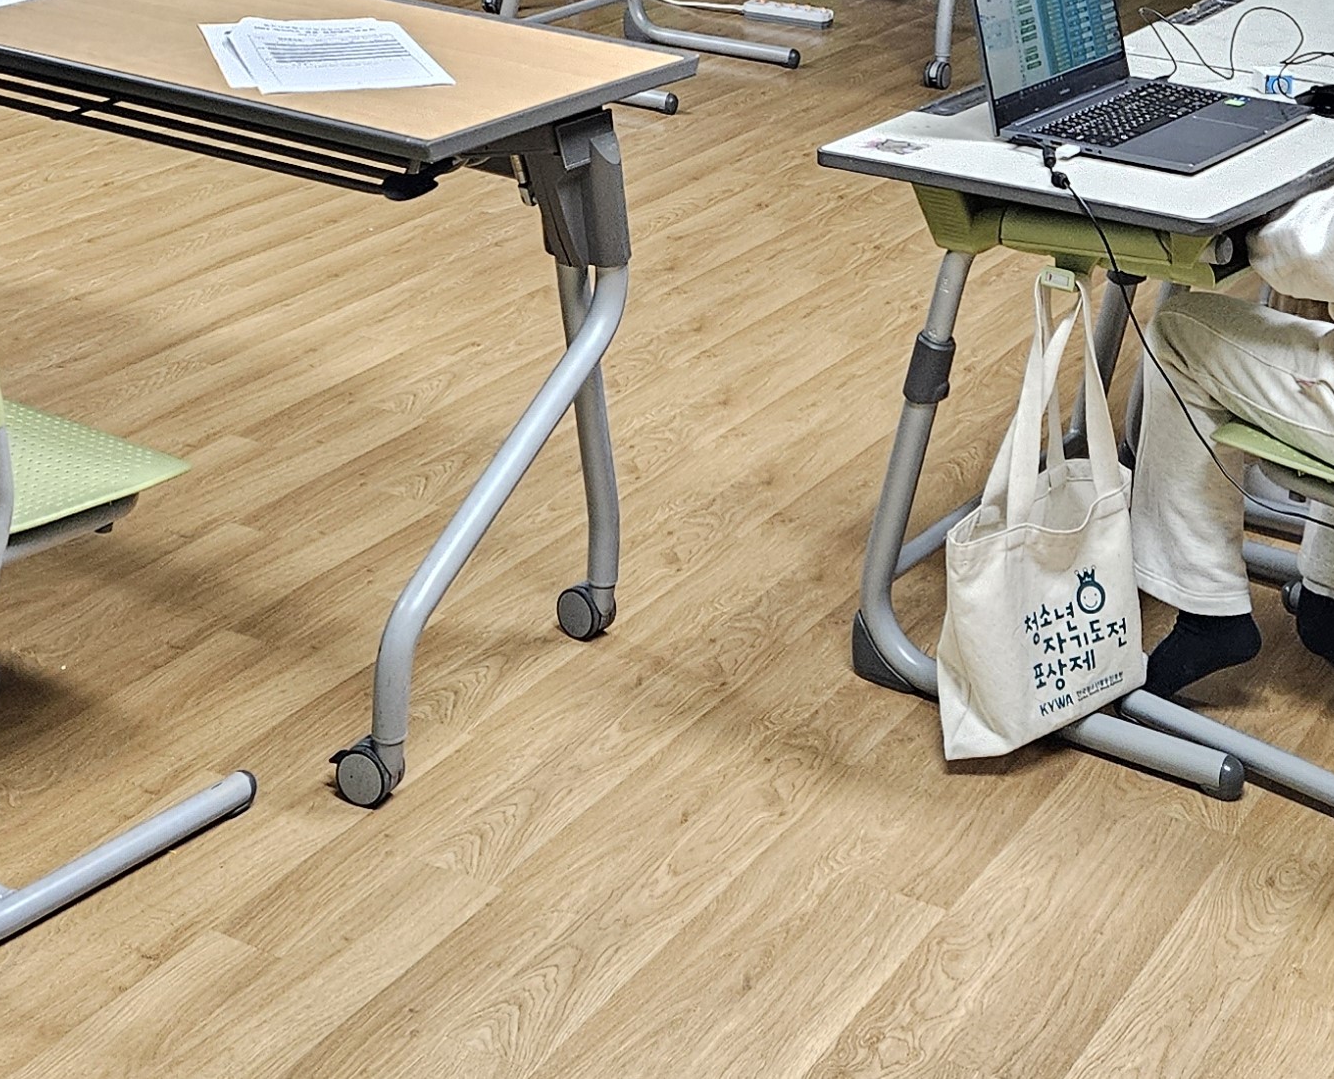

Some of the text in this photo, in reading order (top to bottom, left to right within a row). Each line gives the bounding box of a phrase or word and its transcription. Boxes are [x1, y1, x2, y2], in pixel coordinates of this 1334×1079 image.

[1024, 602, 1077, 645] 청소년
[1042, 618, 1128, 655] 자기도전
[1033, 649, 1096, 691] 포상제
[1039, 693, 1075, 717] KYWA
